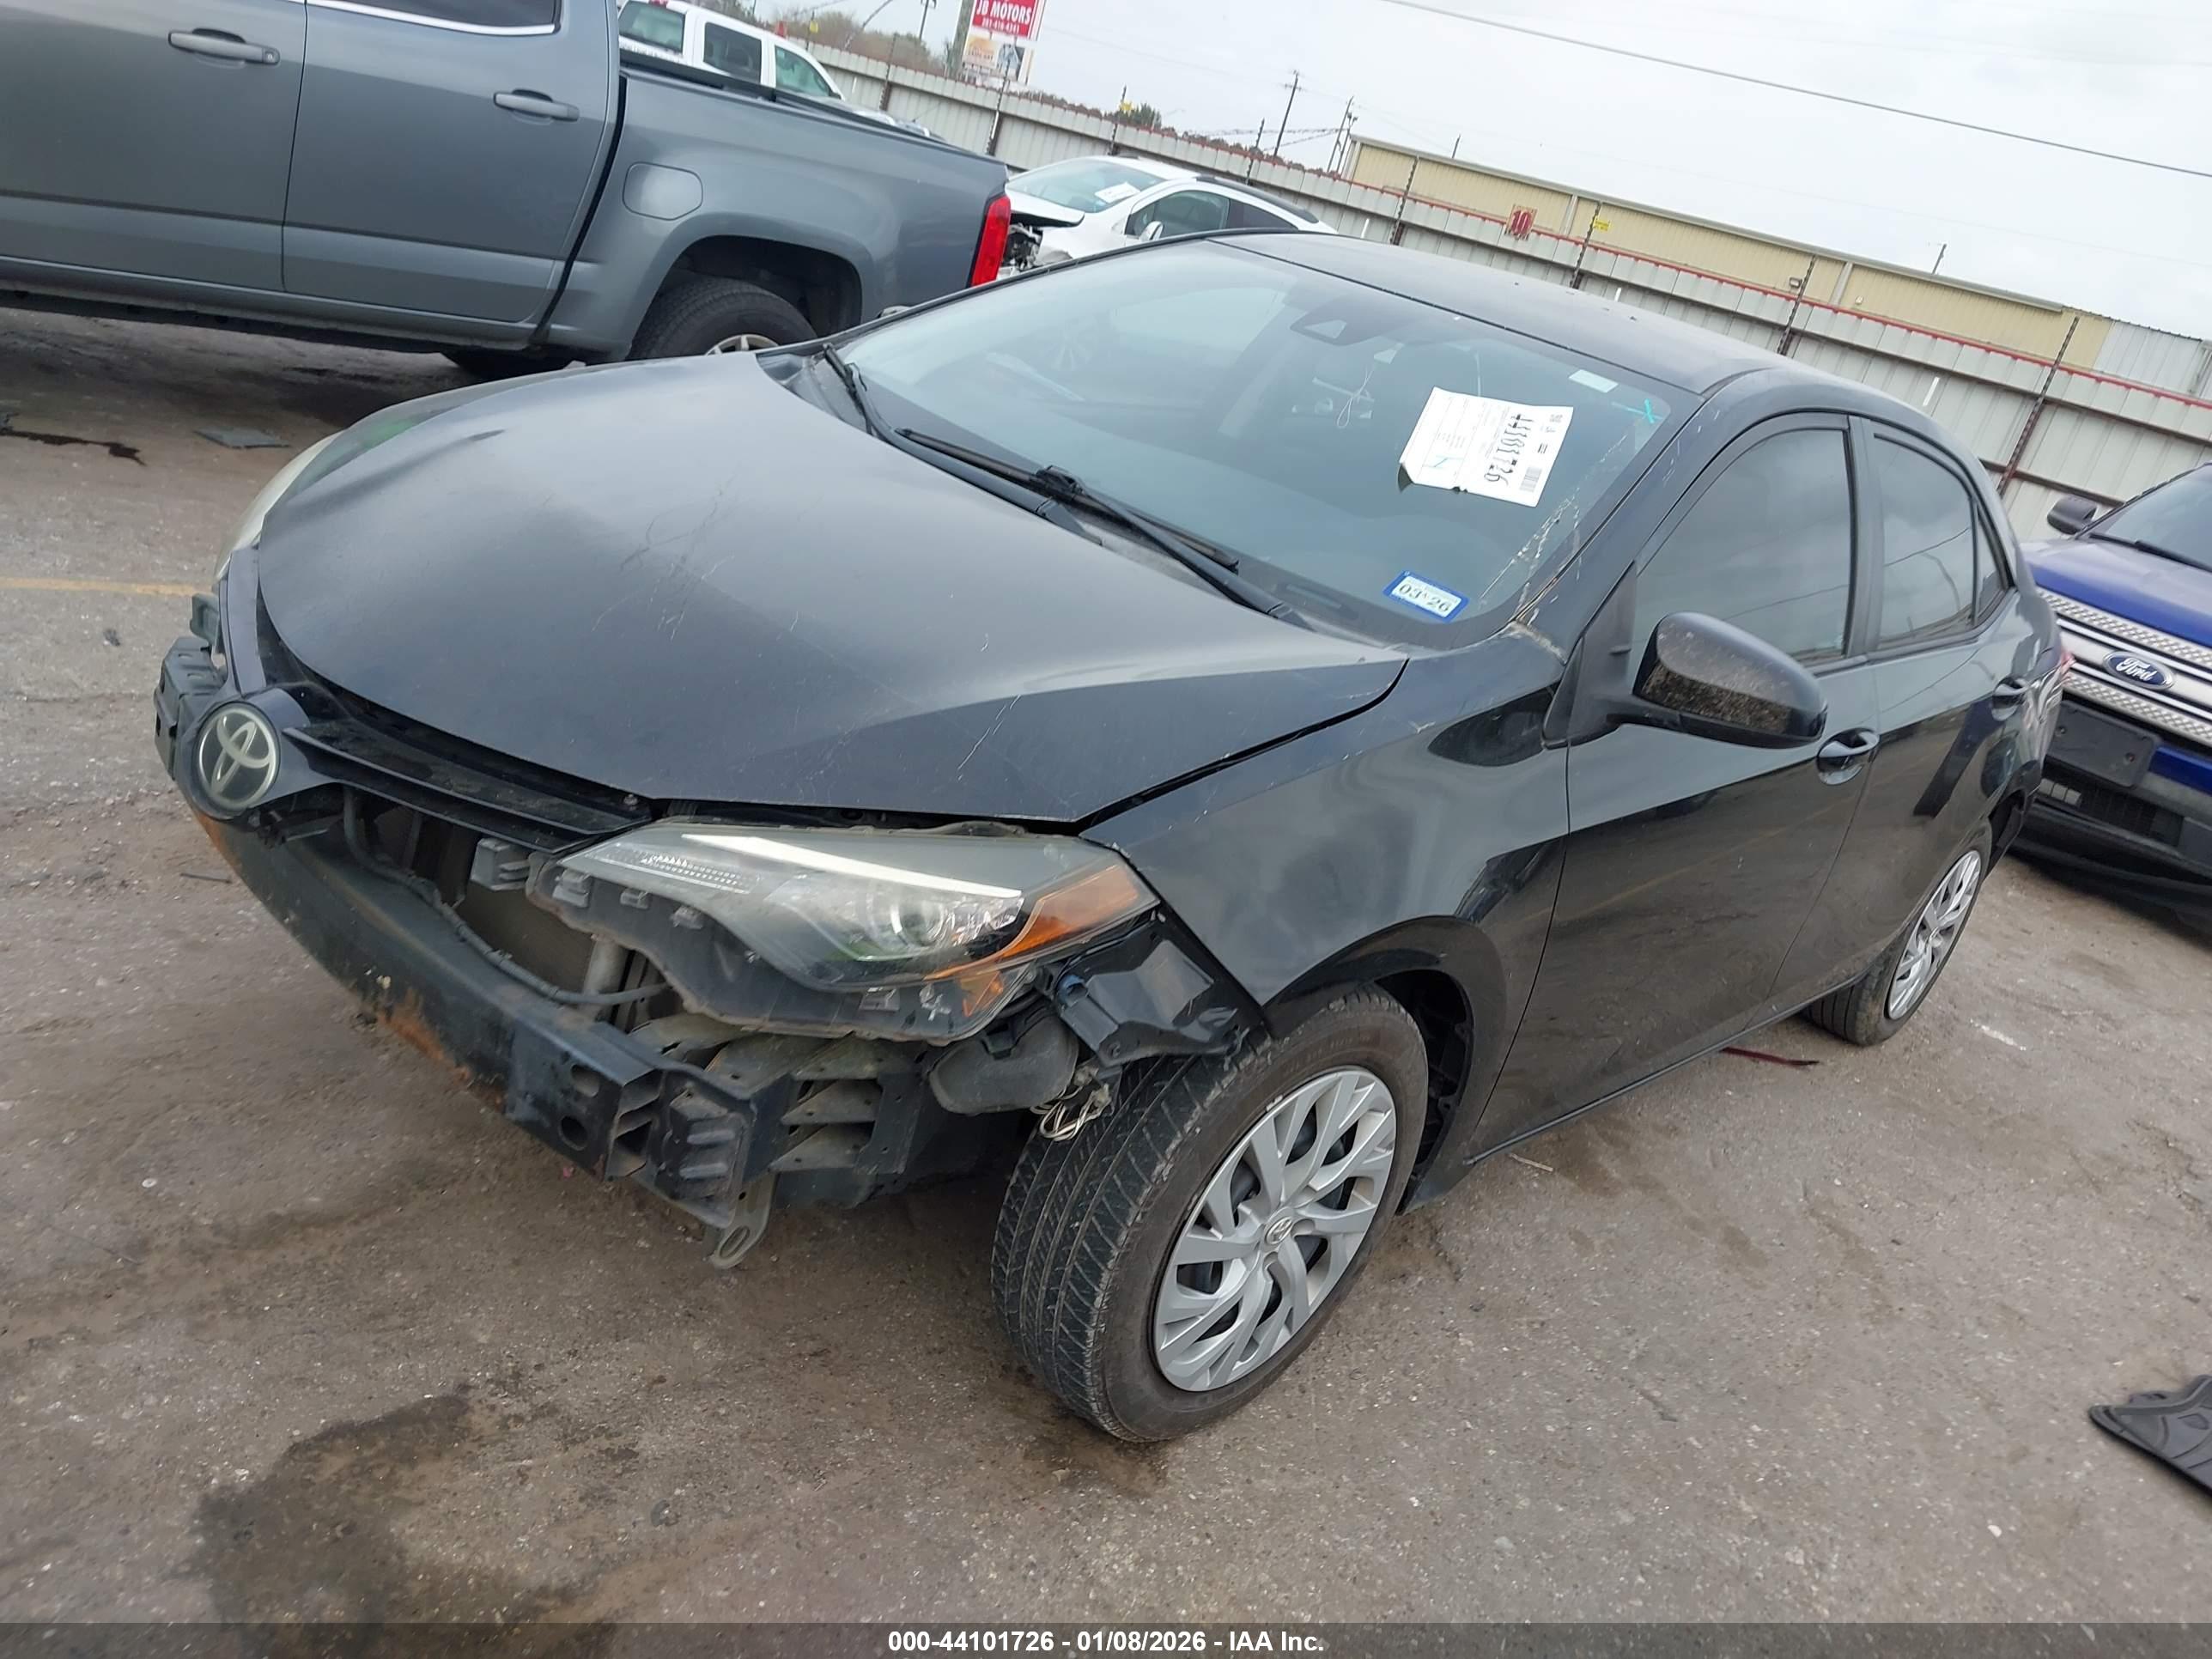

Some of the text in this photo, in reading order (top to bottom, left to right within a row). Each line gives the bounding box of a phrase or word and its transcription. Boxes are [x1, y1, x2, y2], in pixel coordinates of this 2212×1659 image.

[990, 1, 1032, 24] MOTORS
[1511, 210, 1532, 236] 10
[1483, 413, 1534, 486] 44101726
[2116, 657, 2157, 682] Ford
